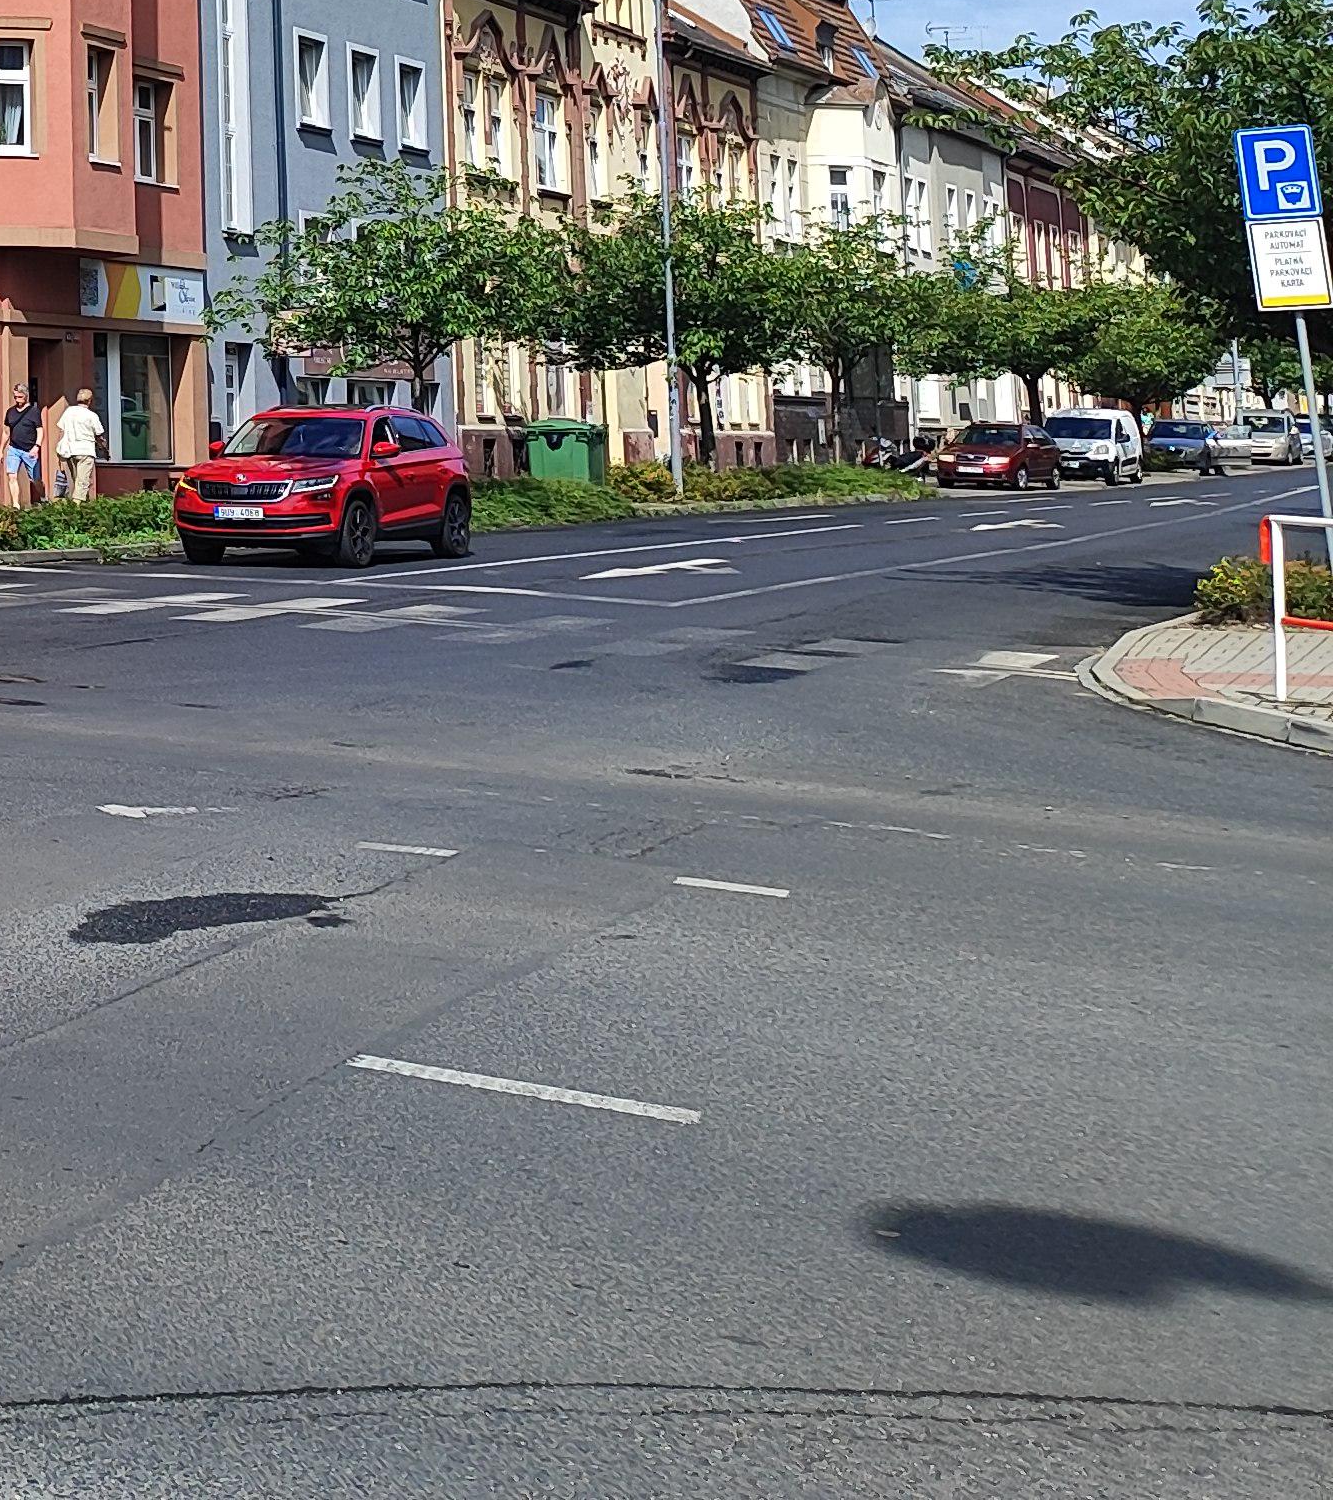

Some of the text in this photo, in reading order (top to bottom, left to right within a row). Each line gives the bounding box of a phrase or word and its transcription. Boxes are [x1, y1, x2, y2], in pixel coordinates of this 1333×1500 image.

[1253, 140, 1296, 191] P
[1269, 239, 1304, 250] AUTOMAT
[1280, 278, 1305, 288] KARTA
